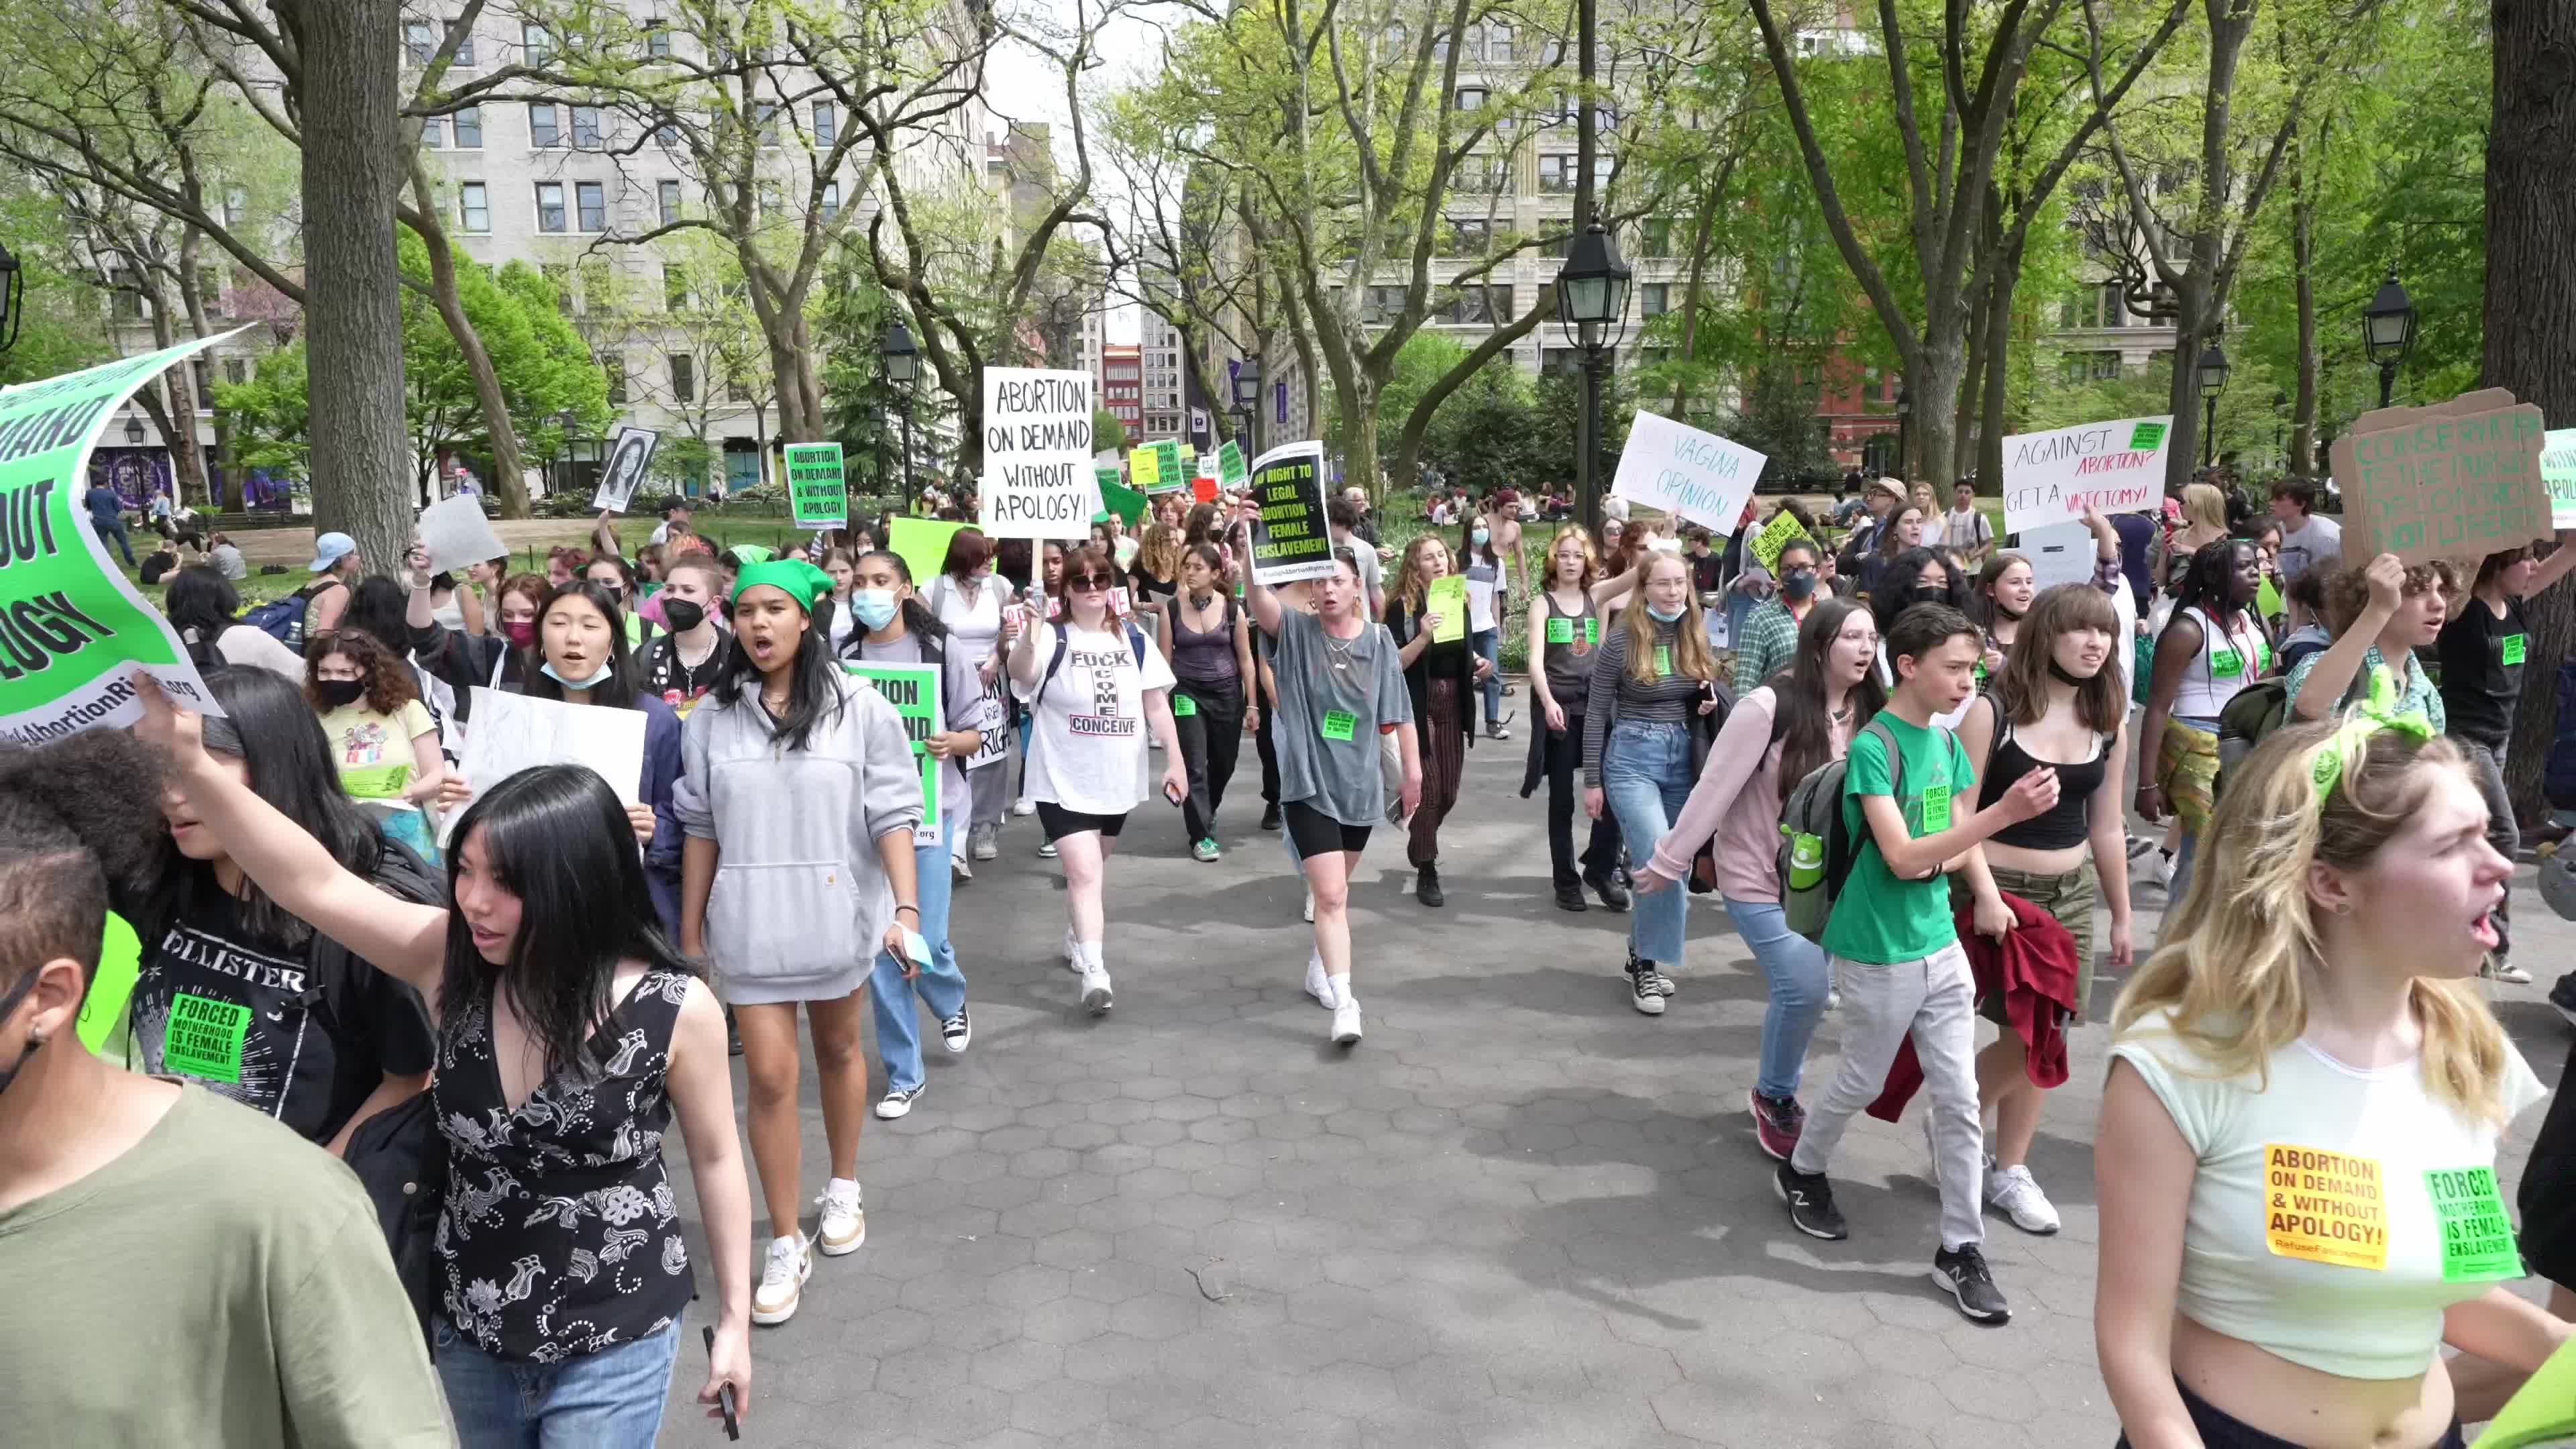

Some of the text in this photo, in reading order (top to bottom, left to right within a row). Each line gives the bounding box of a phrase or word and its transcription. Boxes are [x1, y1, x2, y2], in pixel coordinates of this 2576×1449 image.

[997, 379, 1086, 414] ABORTION
[988, 419, 1090, 453] ON DEMAND
[794, 451, 836, 463] ABORTION
[1675, 435, 1739, 479] VAGINA
[2015, 430, 2112, 468] AGAINST
[792, 468, 842, 480] ON DEMAND
[1267, 466, 1295, 483] RIGHT
[1299, 464, 1311, 479] TO
[2076, 450, 2155, 477] ABORTION?
[1003, 463, 1076, 488] WITHOUT
[797, 485, 841, 496] & WITHOUT
[1267, 484, 1299, 502] LEGAL
[1657, 468, 1729, 517] OPINION
[2007, 487, 2044, 512] GET
[2048, 484, 2059, 503] A
[804, 502, 841, 514] APOLOGY
[995, 494, 1087, 523] APOLOGY!
[1268, 521, 1309, 539] FEMALE
[1255, 538, 1326, 559] ENSLAVEMENT
[1071, 651, 1130, 666] FUCK
[1073, 717, 1135, 733] CONCEIVE
[1927, 786, 1947, 800] FORCED
[177, 998, 239, 1027] FORCED
[172, 1018, 233, 1039] MOTHERHOOD
[172, 1031, 231, 1053] IS FEMALE
[170, 1045, 231, 1065] ENSLAVEMENT
[2271, 1148, 2374, 1181] ABORTION
[2271, 1171, 2377, 1199] ON DEMAND
[2430, 1169, 2493, 1199] FORCED
[2273, 1193, 2378, 1221] & WITHOUT
[2270, 1213, 2383, 1246] APOLOGY!
[2446, 1221, 2460, 1240] IS
